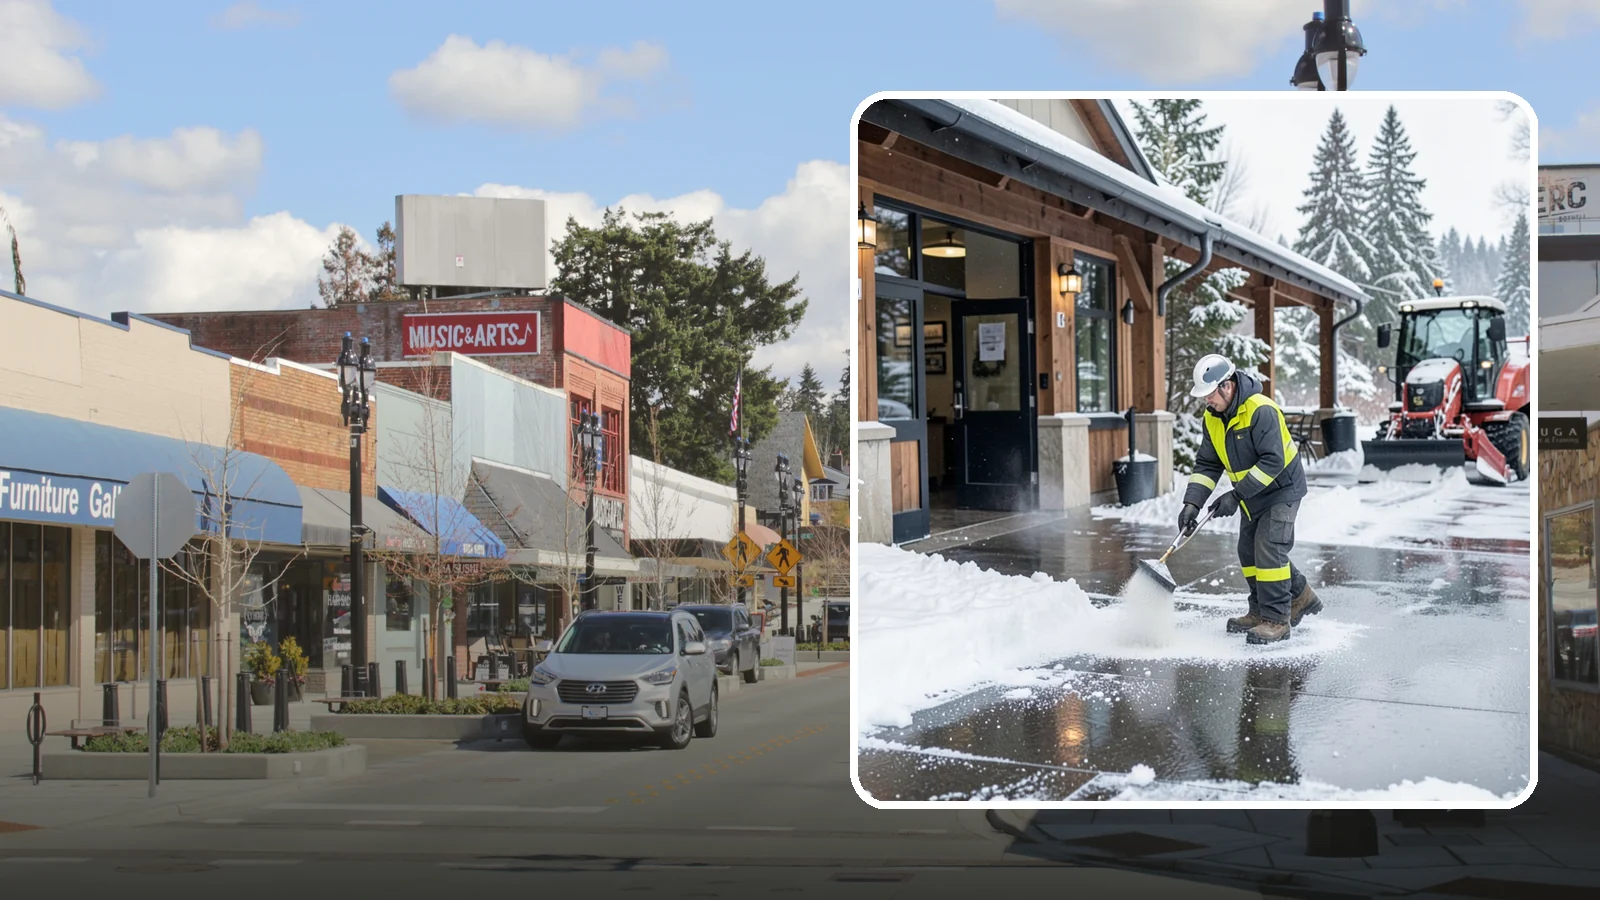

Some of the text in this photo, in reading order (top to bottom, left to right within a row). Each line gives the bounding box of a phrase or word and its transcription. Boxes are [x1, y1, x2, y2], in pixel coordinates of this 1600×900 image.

[408, 322, 520, 349] MUSIC&ARTS
[0, 471, 122, 519] Furniture Gal
[453, 563, 479, 574] SUSHI
